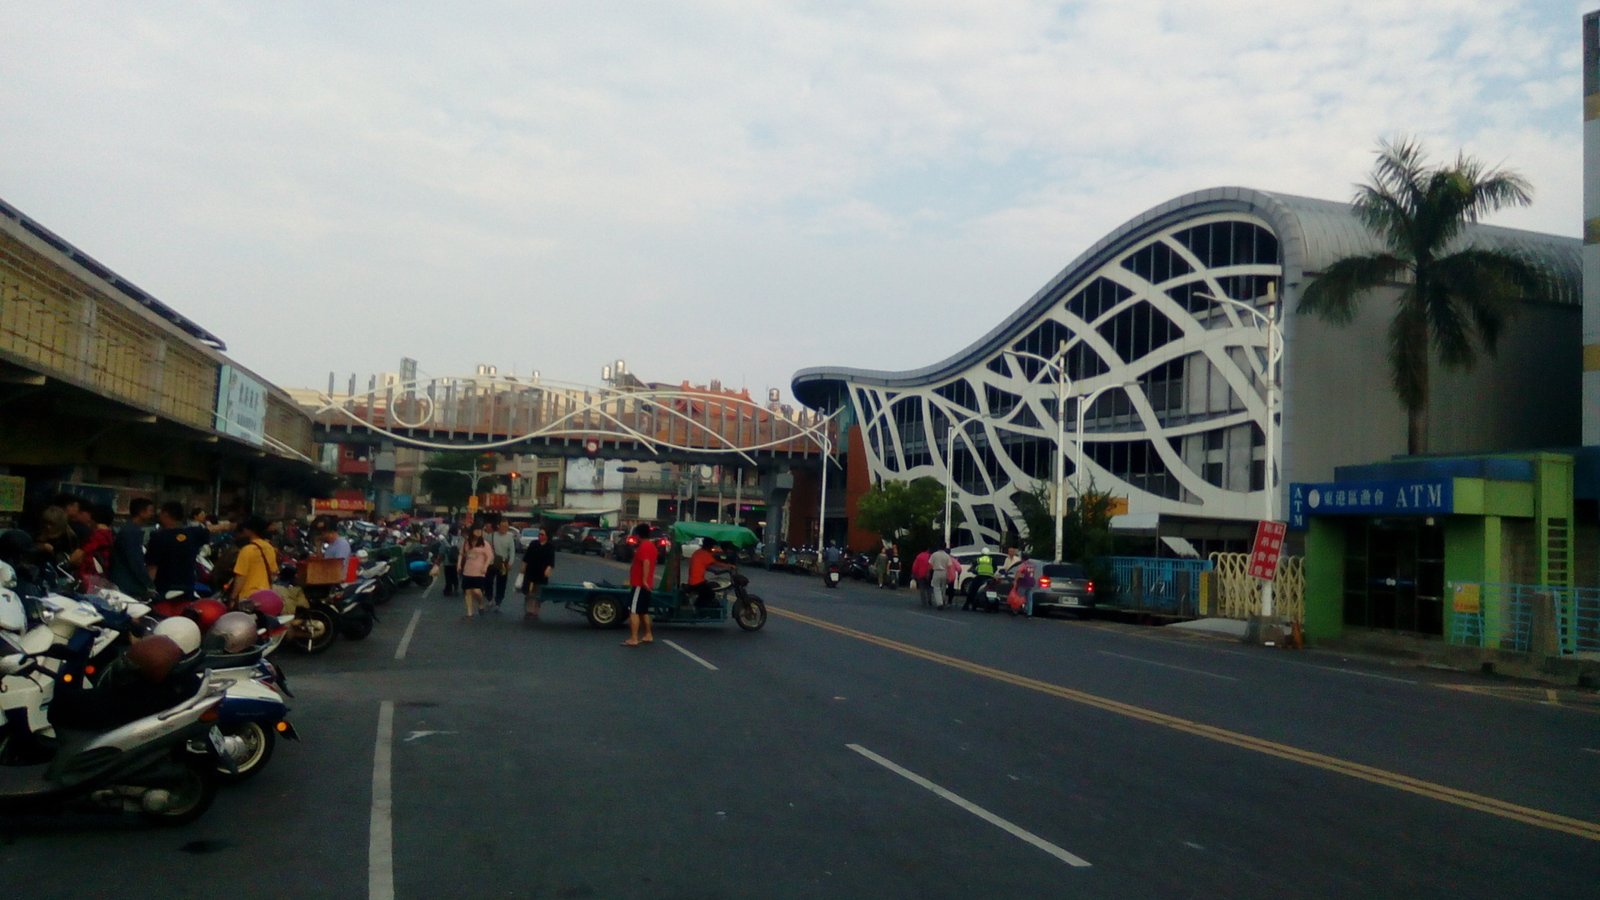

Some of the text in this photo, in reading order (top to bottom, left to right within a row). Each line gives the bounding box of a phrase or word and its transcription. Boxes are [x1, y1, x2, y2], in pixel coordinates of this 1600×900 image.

[1294, 487, 1303, 527] ATM
[1324, 483, 1442, 508] 東港區漁會 ATM
